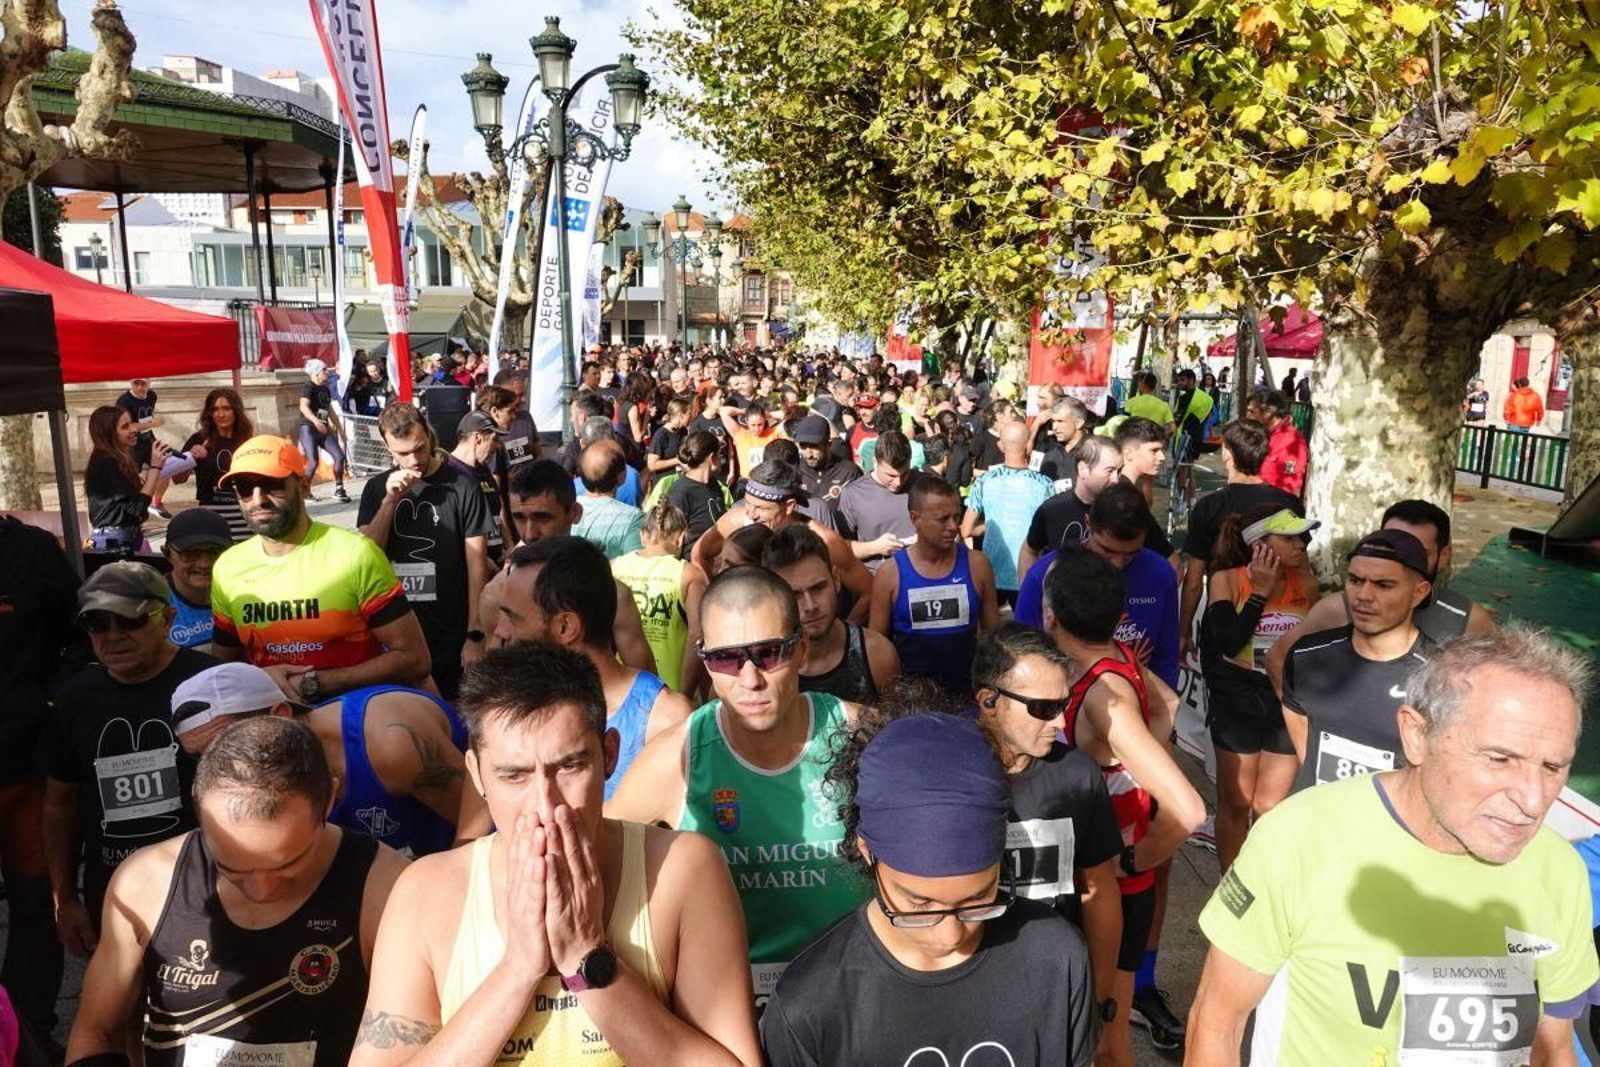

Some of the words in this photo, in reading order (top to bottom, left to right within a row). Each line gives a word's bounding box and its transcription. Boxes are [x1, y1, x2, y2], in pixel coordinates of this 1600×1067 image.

[540, 256, 558, 329] DEPORTE
[242, 599, 320, 624] 3NORTH
[924, 600, 943, 617] 19
[1128, 597, 1157, 605] OYSHO
[114, 771, 163, 802] 801
[720, 846, 748, 864] AN
[740, 865, 826, 889] MARÍN
[156, 964, 170, 980] El
[172, 966, 220, 990] Trigal
[1432, 967, 1447, 979] EU
[1428, 996, 1519, 1042] 695
